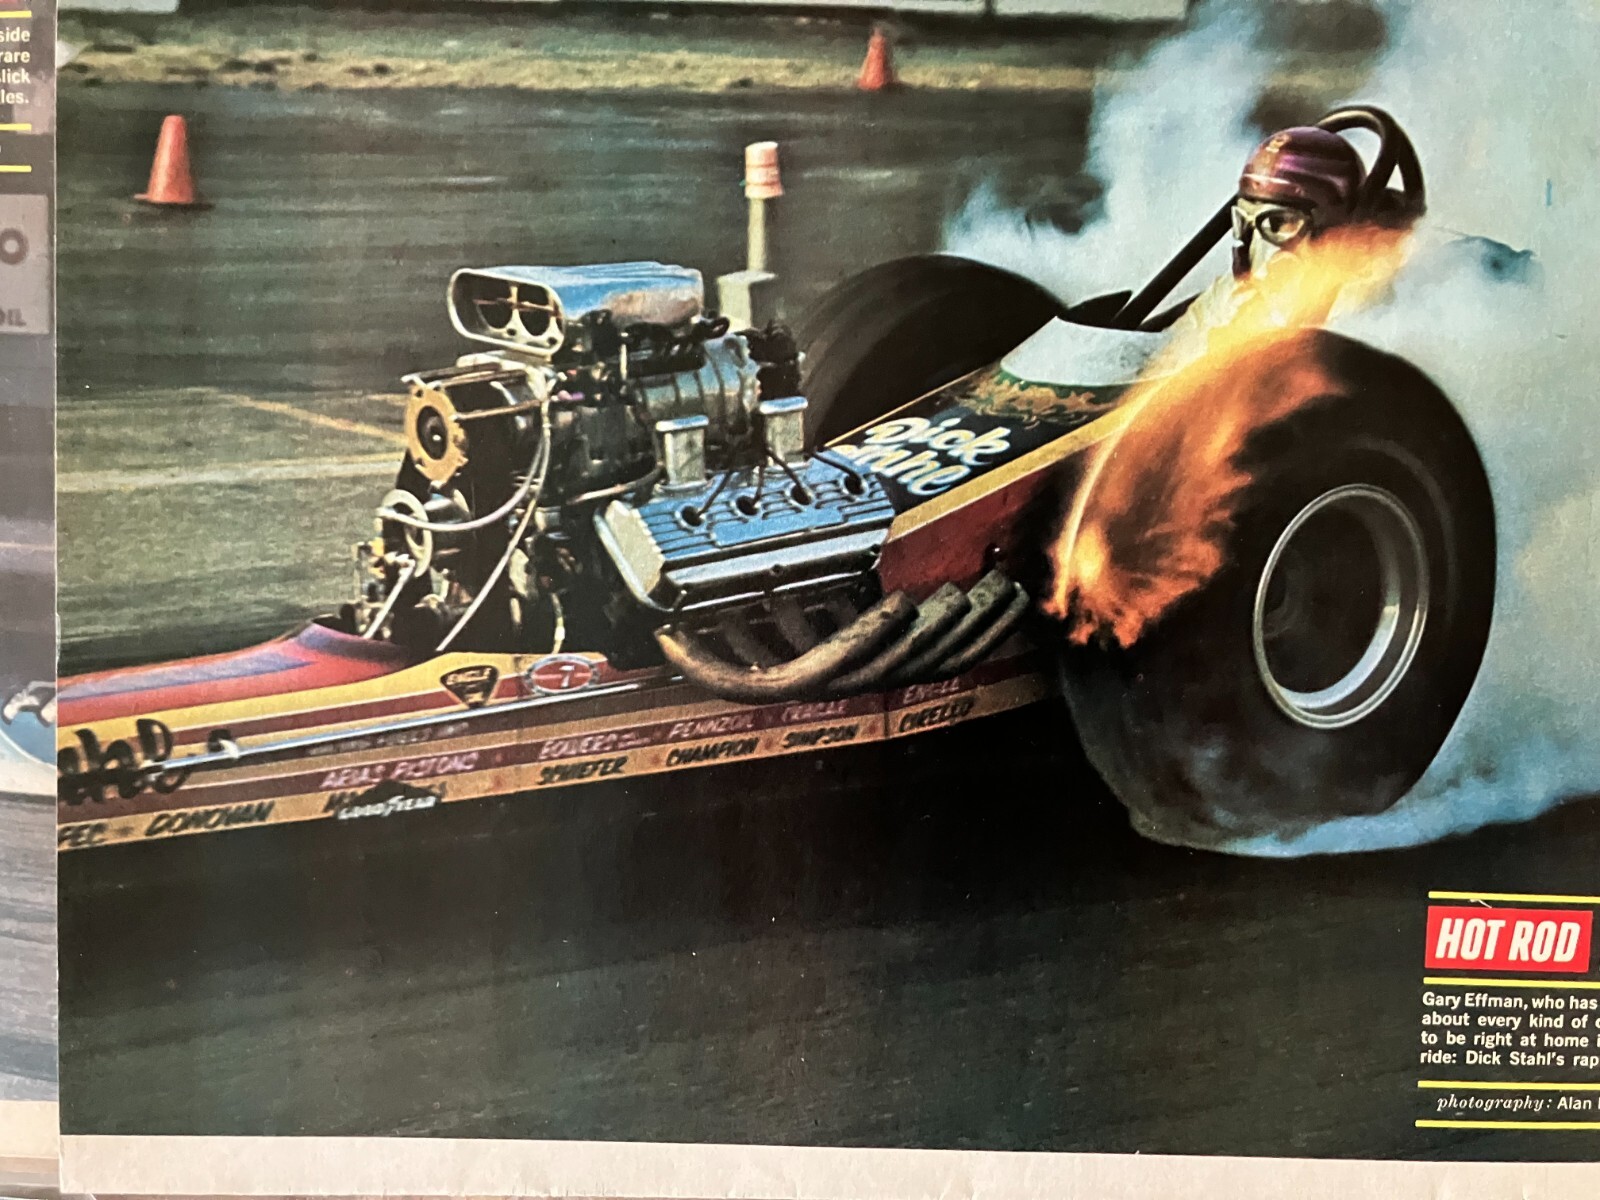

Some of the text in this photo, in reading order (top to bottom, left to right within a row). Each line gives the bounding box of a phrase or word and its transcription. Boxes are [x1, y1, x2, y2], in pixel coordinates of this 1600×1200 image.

[0, 68, 31, 84] lick
[864, 417, 1011, 465] Dick
[666, 737, 760, 767] CHAMPION
[145, 800, 276, 837] DONOVAN
[1435, 918, 1581, 963] HOT ROD
[1422, 992, 1598, 1010] Gary Effman, who has
[1421, 1011, 1470, 1026] about
[1477, 1015, 1521, 1031] every
[1529, 1013, 1564, 1028] kind
[1571, 1014, 1588, 1028] of
[1420, 1032, 1438, 1045] to
[1446, 1031, 1466, 1045] be
[1473, 1032, 1512, 1050] right
[1520, 1033, 1536, 1046] at
[1544, 1033, 1589, 1047] home
[1420, 1050, 1599, 1069] ride: Dick Stahl's rap
[1436, 1094, 1552, 1112] photography:
[1557, 1096, 1592, 1110] Alan
